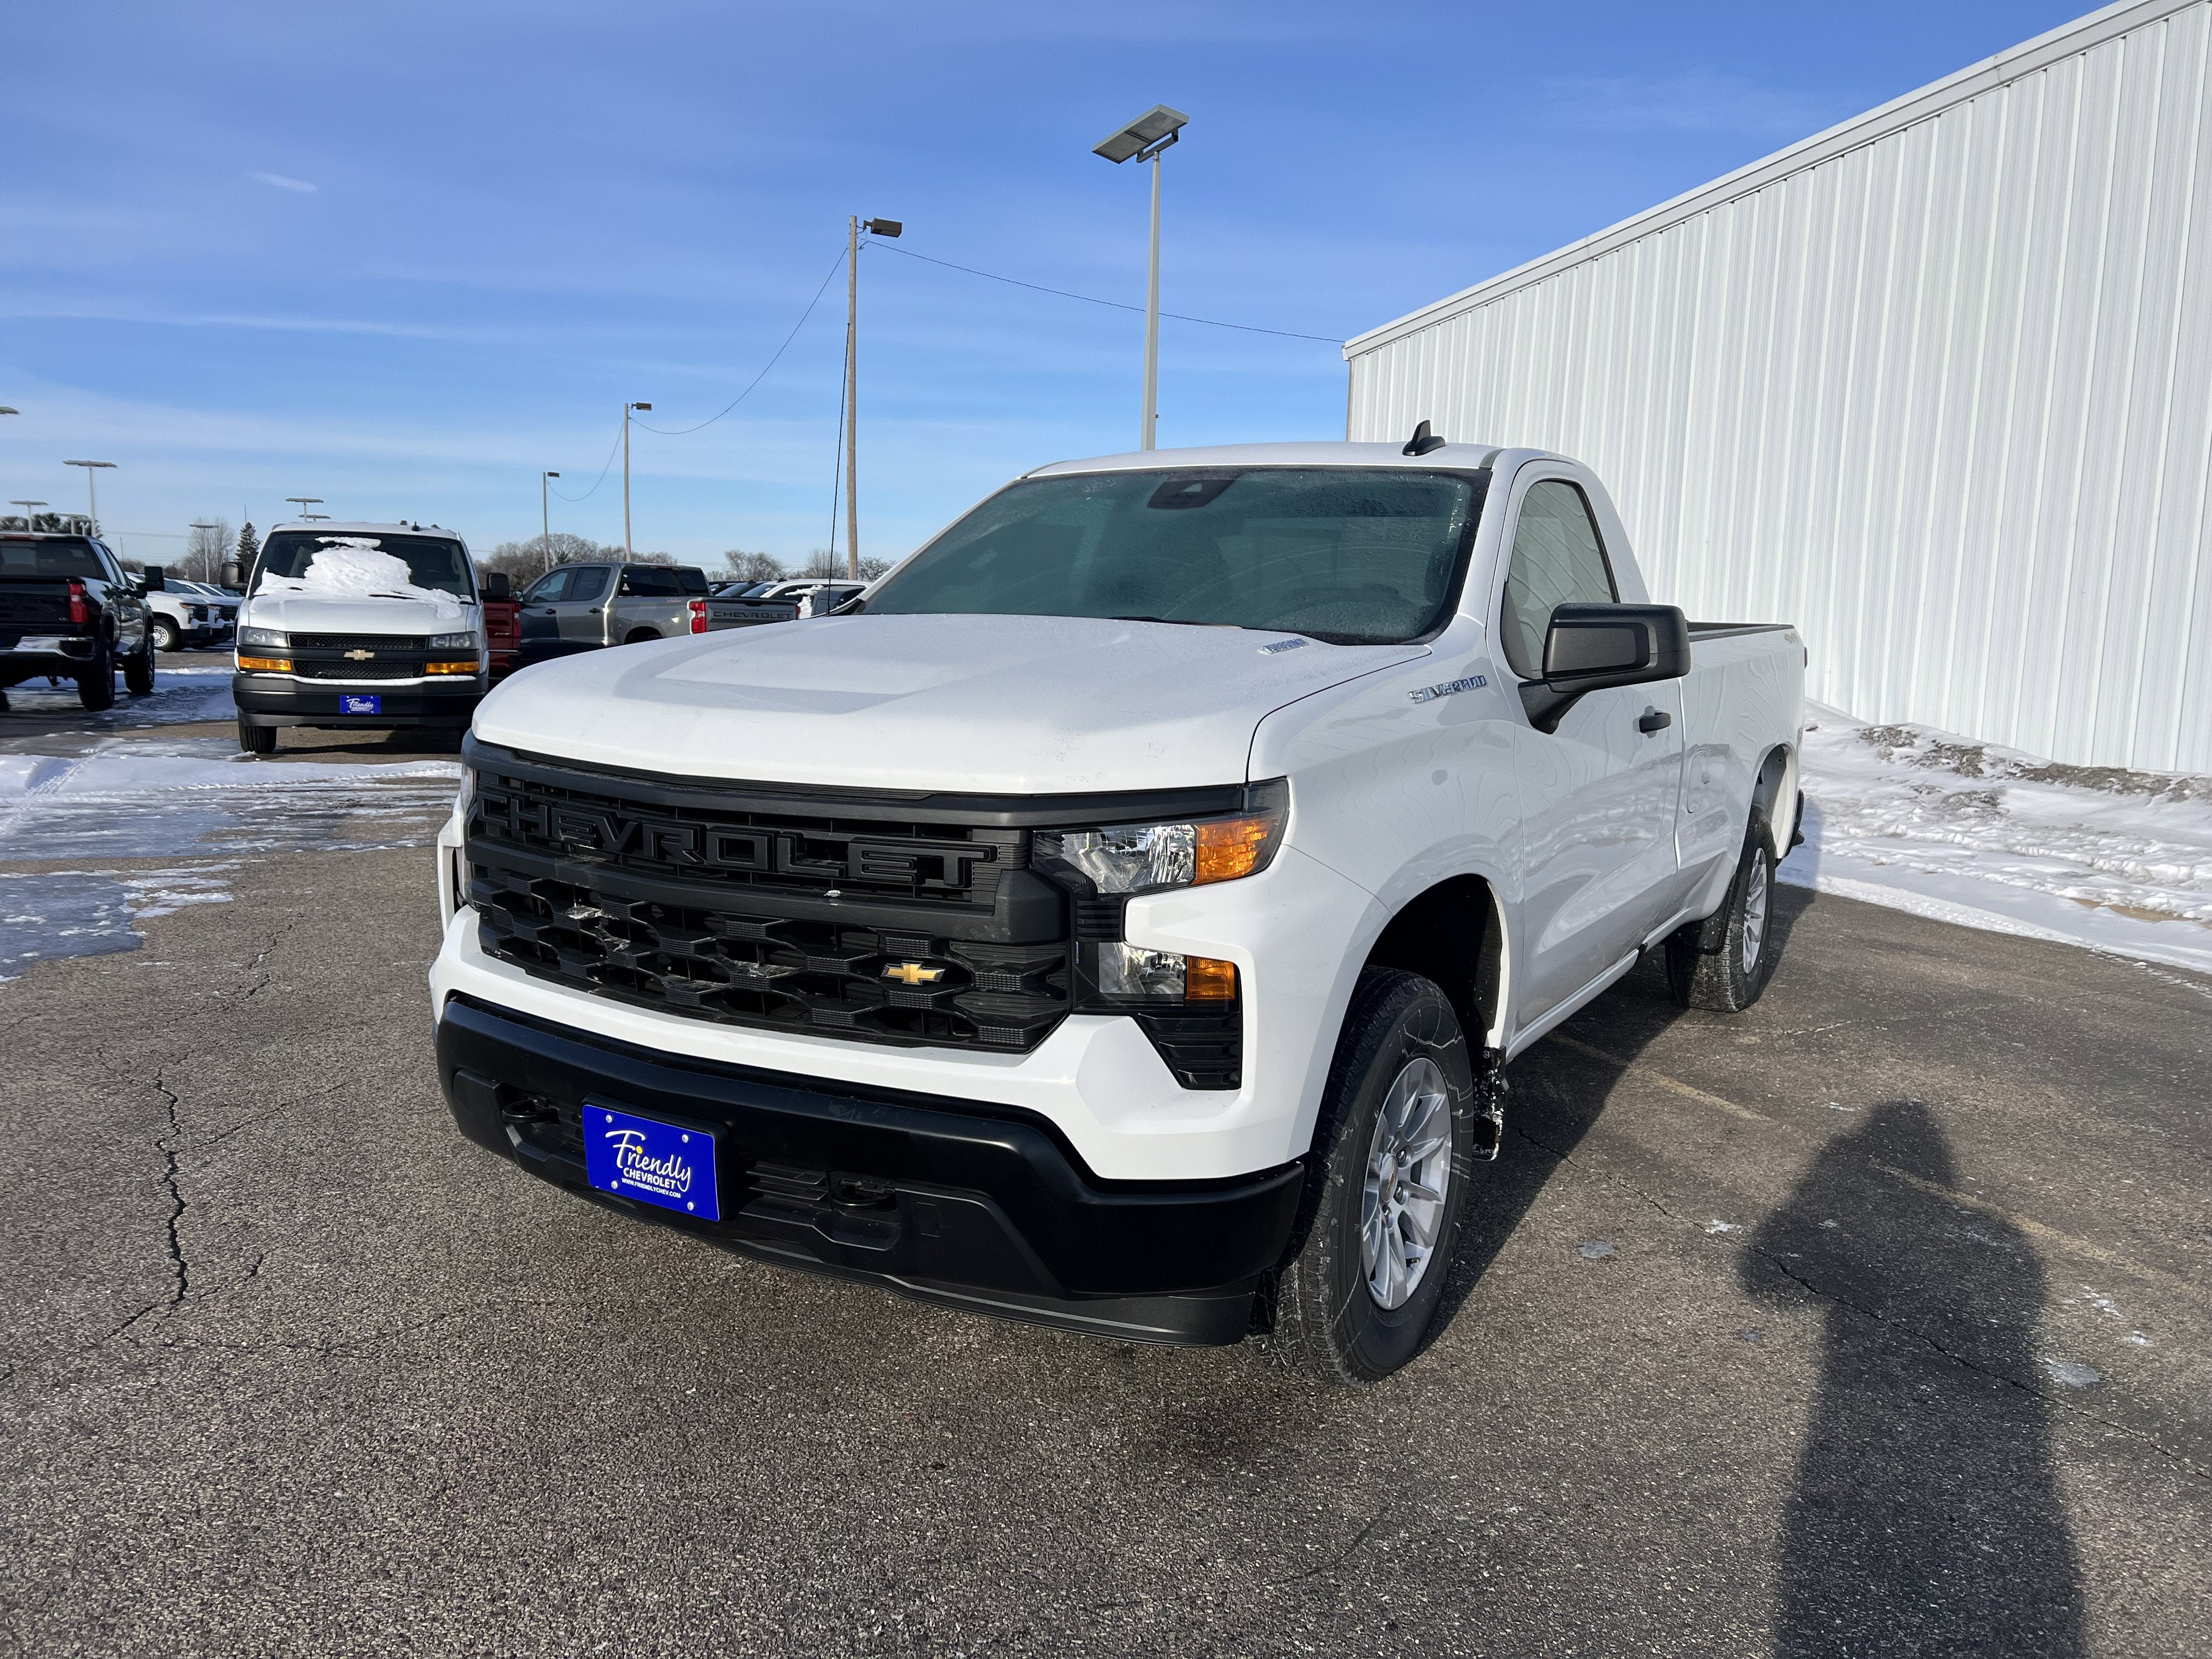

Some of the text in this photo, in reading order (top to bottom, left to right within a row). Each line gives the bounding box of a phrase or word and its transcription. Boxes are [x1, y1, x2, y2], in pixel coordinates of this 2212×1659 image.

[714, 611, 792, 619] CHEVROLET
[346, 698, 374, 709] Friendly
[476, 785, 998, 888] CHEVROLET
[605, 1130, 691, 1192] Friendly
[621, 1177, 681, 1199] WWW.FRIENDLYCHEV.COM
[623, 1167, 676, 1189] CHEVROLET
